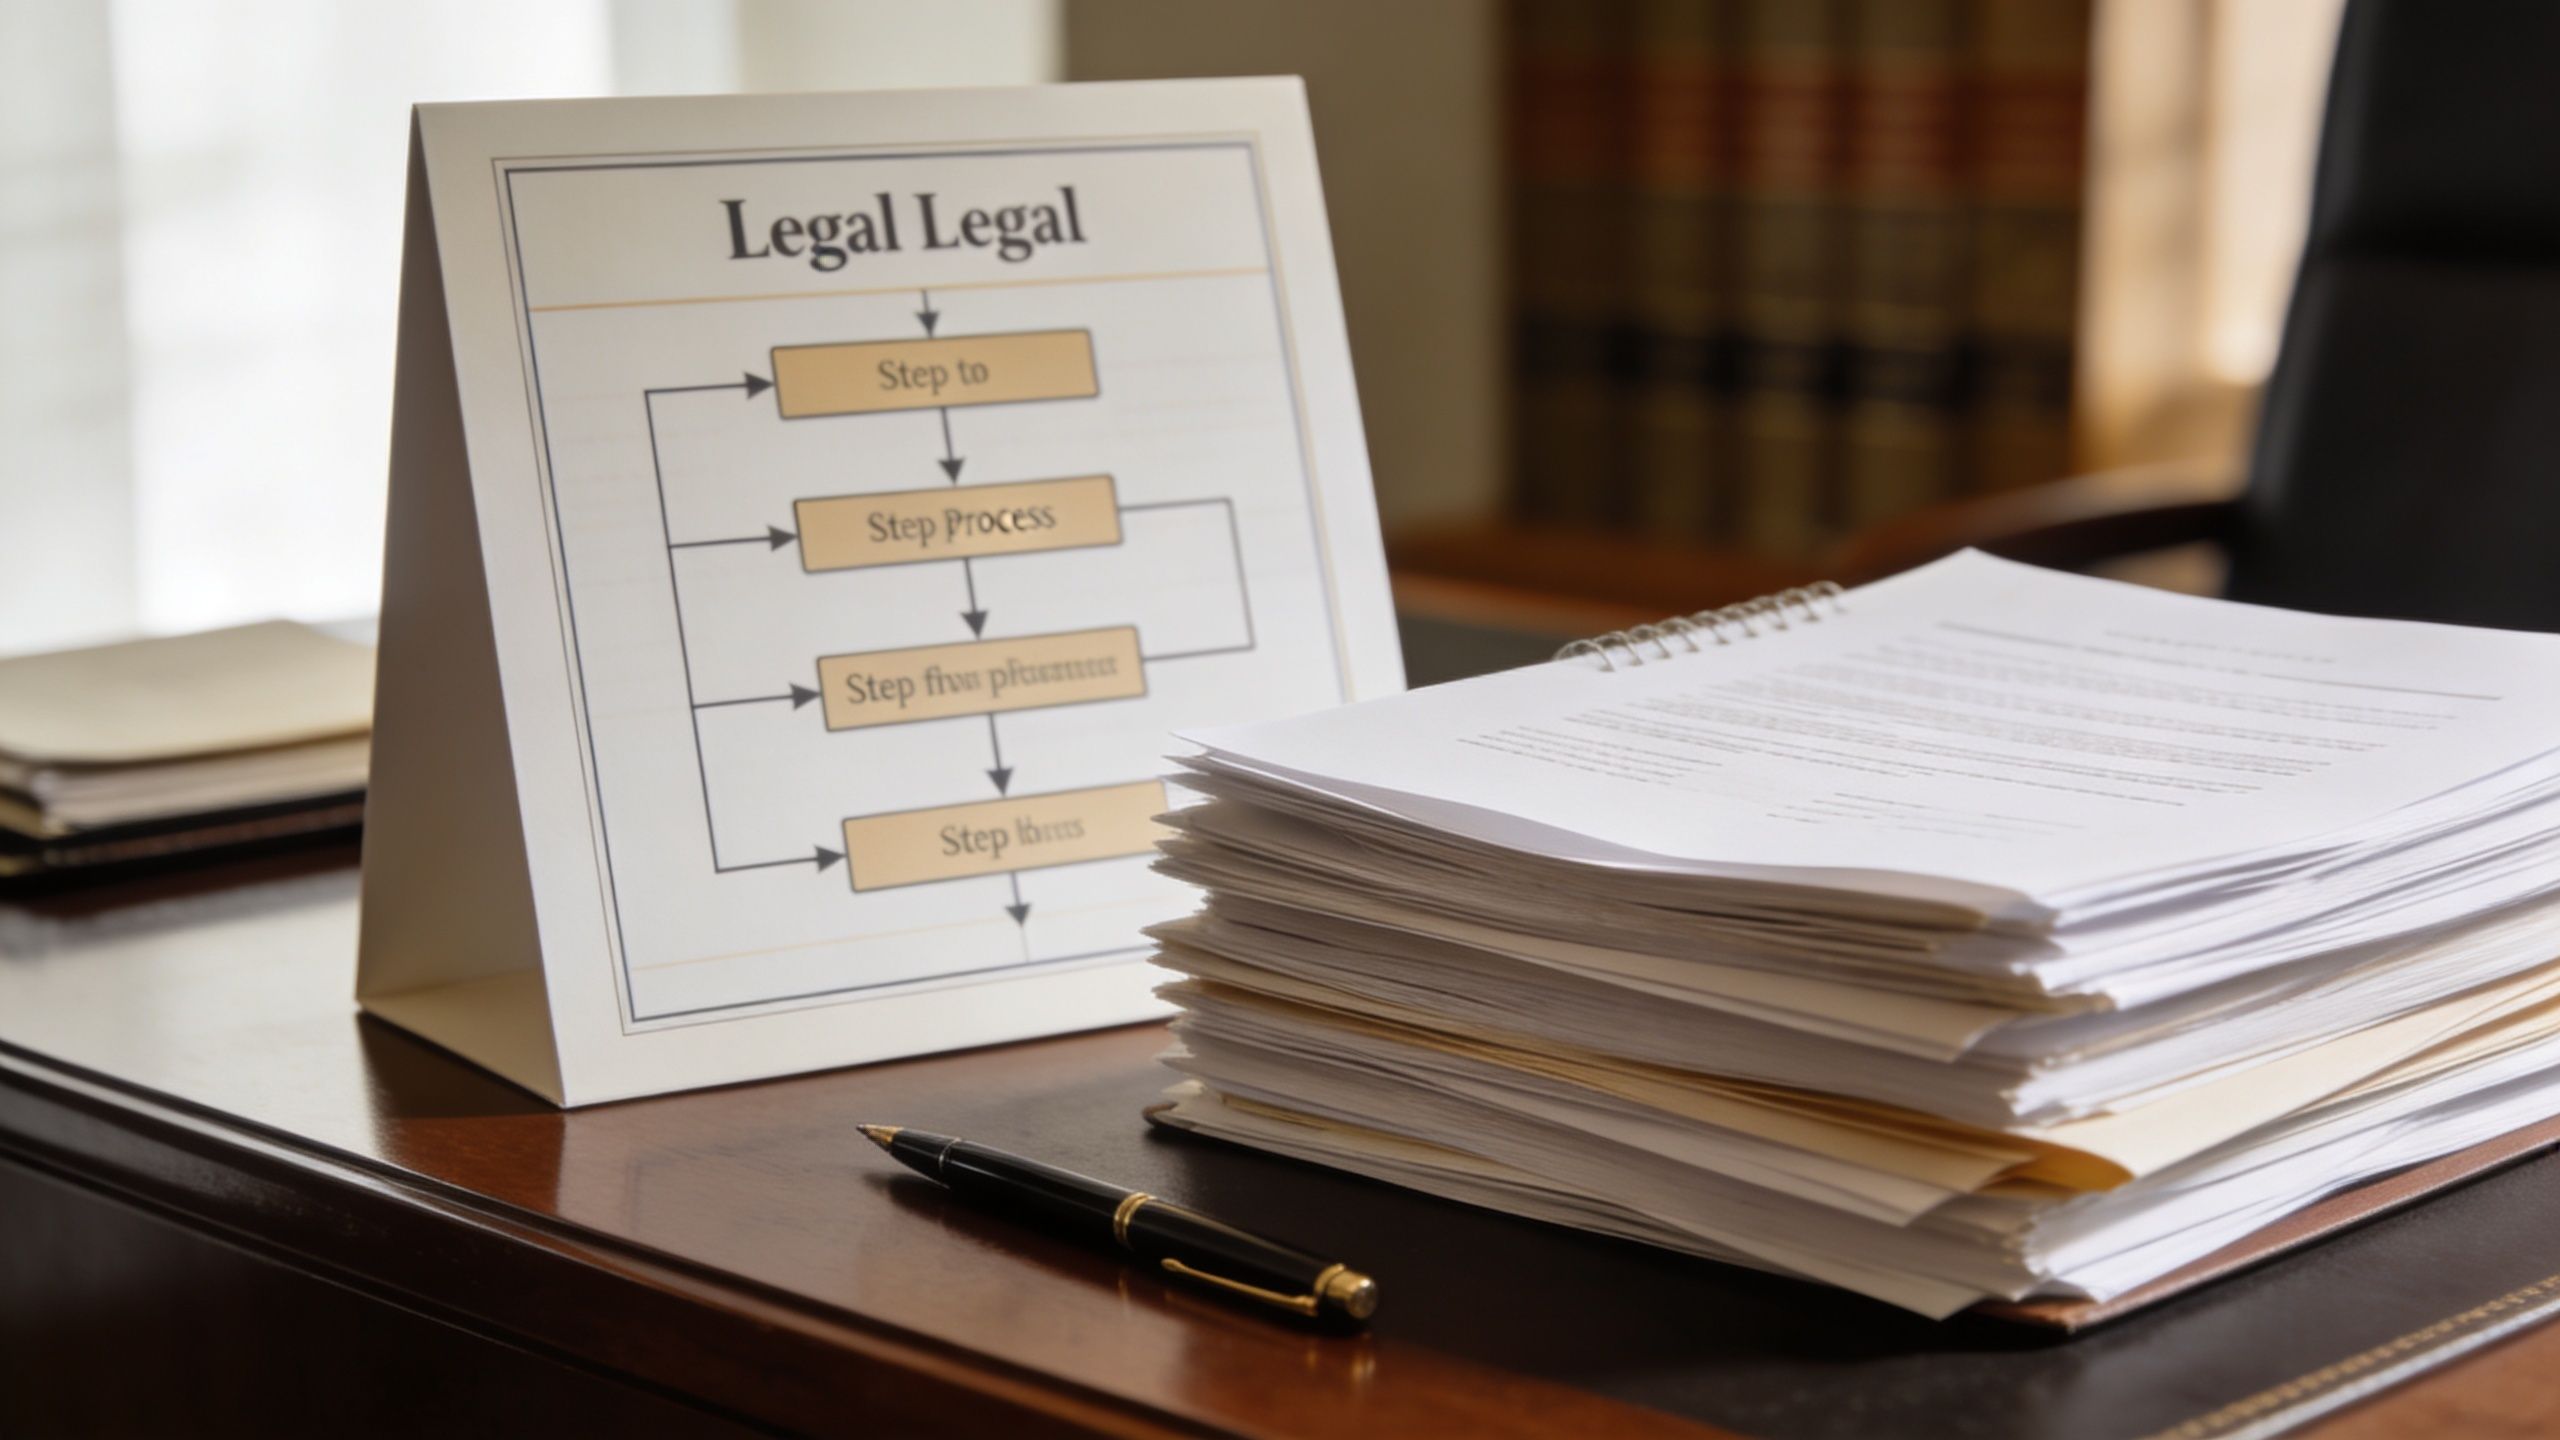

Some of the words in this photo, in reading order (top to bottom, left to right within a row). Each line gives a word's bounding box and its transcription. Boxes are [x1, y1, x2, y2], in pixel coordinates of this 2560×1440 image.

[720, 192, 901, 272] Legal
[913, 186, 1087, 263] Legal
[878, 359, 949, 396] Step
[958, 358, 989, 386] to
[867, 511, 936, 547] Step
[944, 506, 1056, 543] Process
[846, 672, 915, 708] Step
[939, 824, 1009, 860] Step
